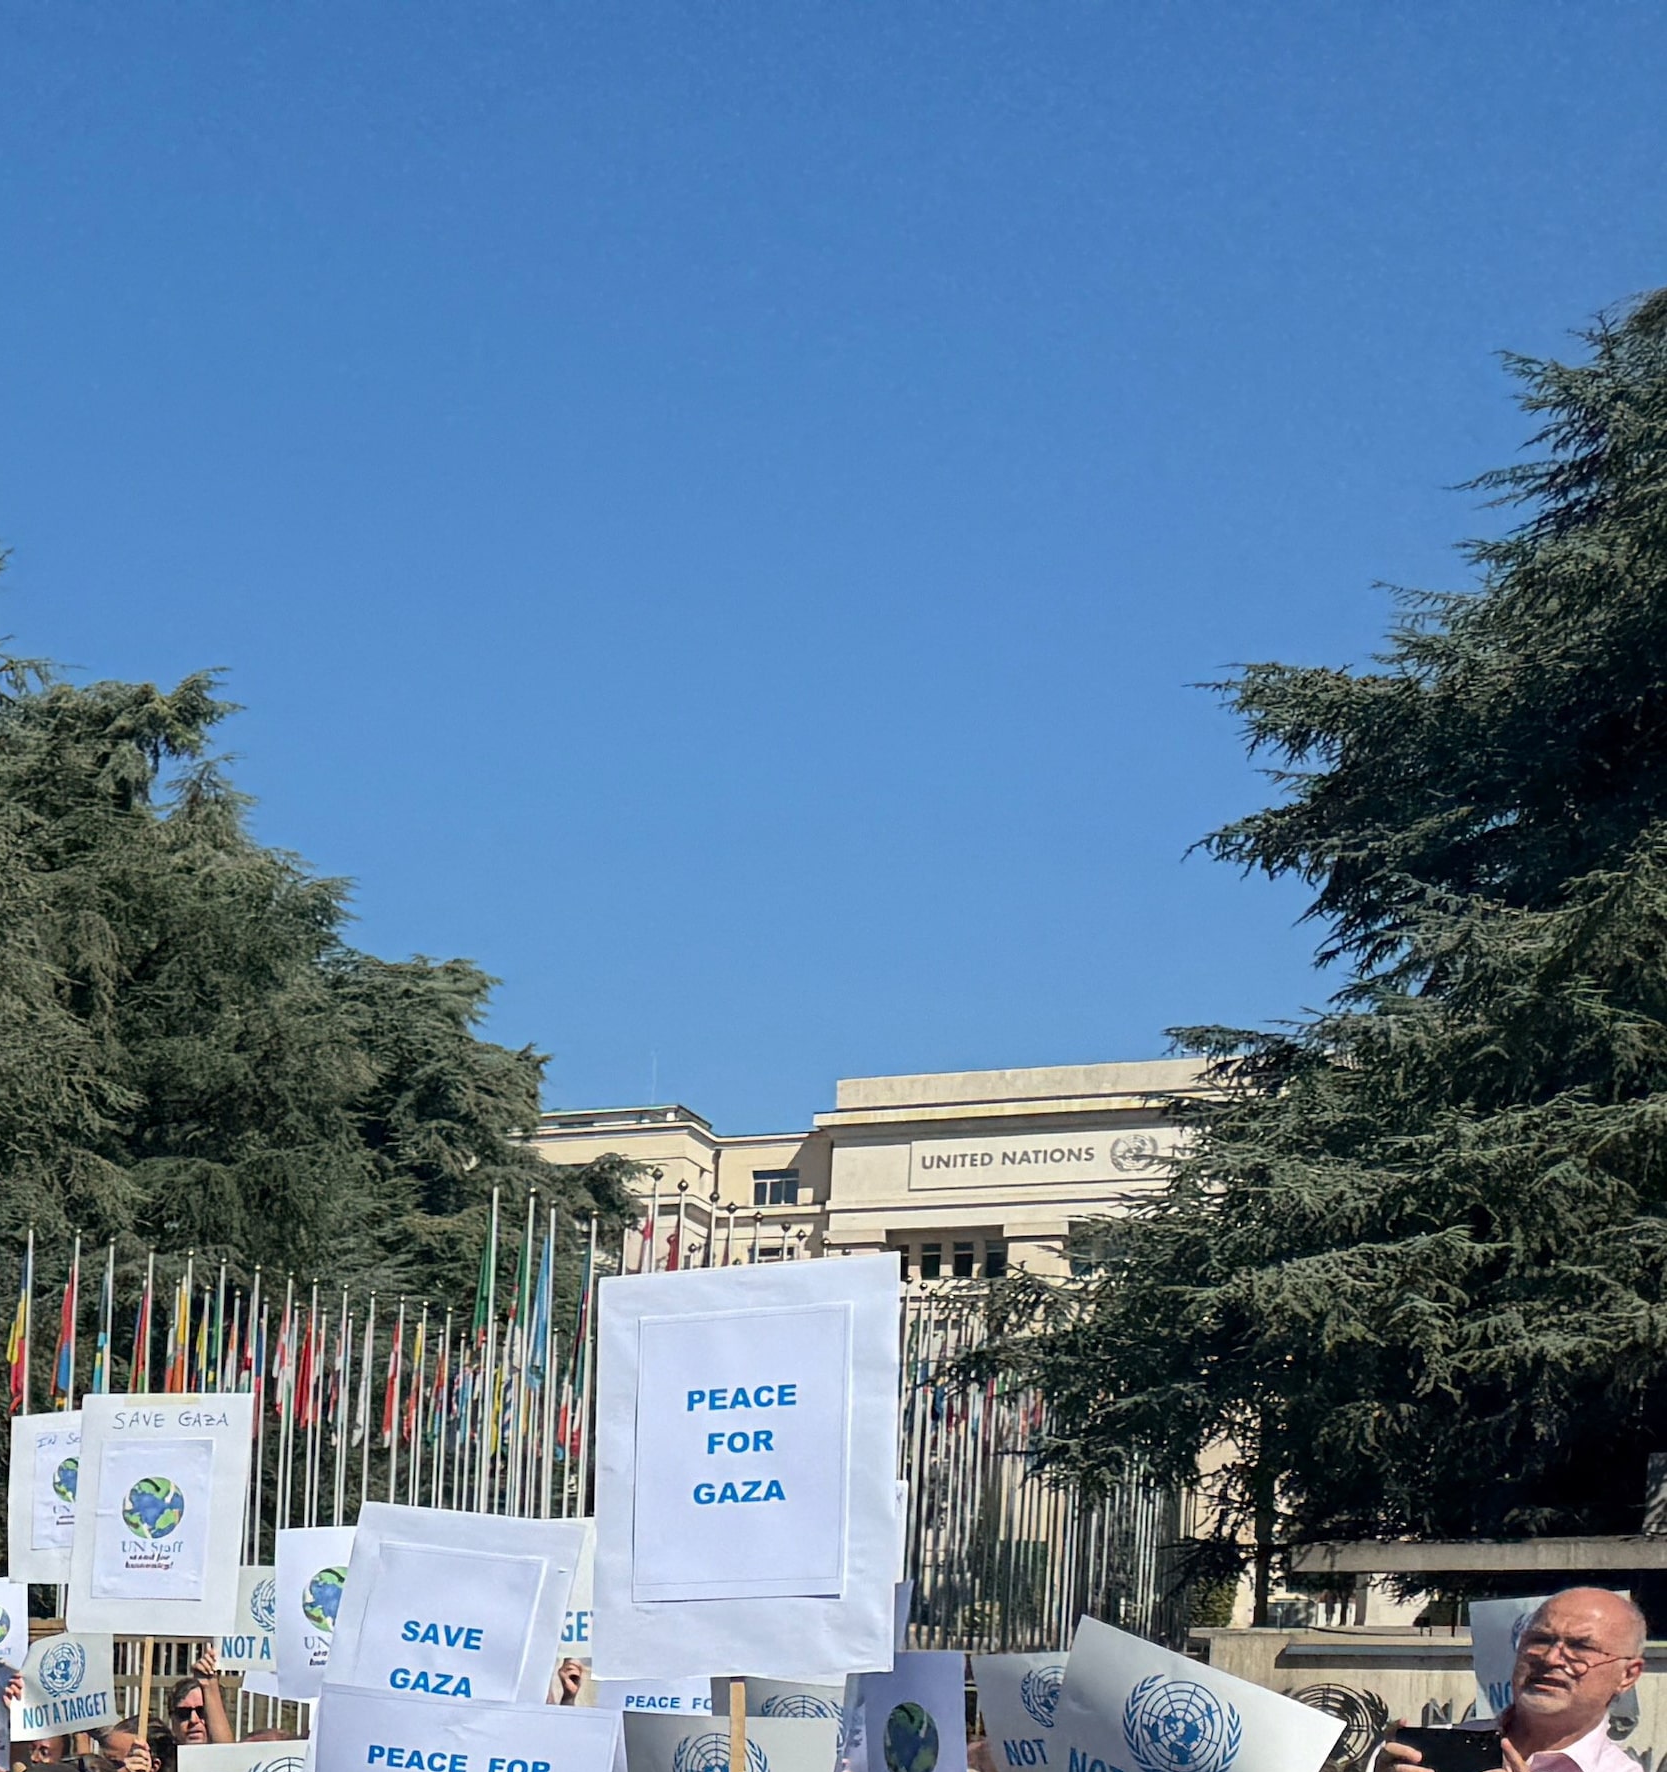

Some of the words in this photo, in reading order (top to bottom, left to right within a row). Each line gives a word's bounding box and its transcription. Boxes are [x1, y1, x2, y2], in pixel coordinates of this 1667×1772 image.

[921, 1152, 993, 1170] UNITED
[1001, 1147, 1095, 1166] NATIONS
[687, 1384, 797, 1412] PEACE
[112, 1411, 166, 1430] SAVE
[178, 1411, 230, 1428] GAZA
[707, 1430, 774, 1455] FOR
[693, 1480, 786, 1505] GAZA
[121, 1541, 146, 1553] UN
[221, 1635, 256, 1659] NOT
[260, 1636, 271, 1660] A
[400, 1619, 484, 1651] SAVE
[388, 1667, 472, 1698] GAZA
[22, 1705, 52, 1729] NOT
[52, 1702, 61, 1723] A
[60, 1691, 108, 1722] TARGET
[625, 1695, 681, 1709] PEACE
[1003, 1737, 1049, 1767] NOT
